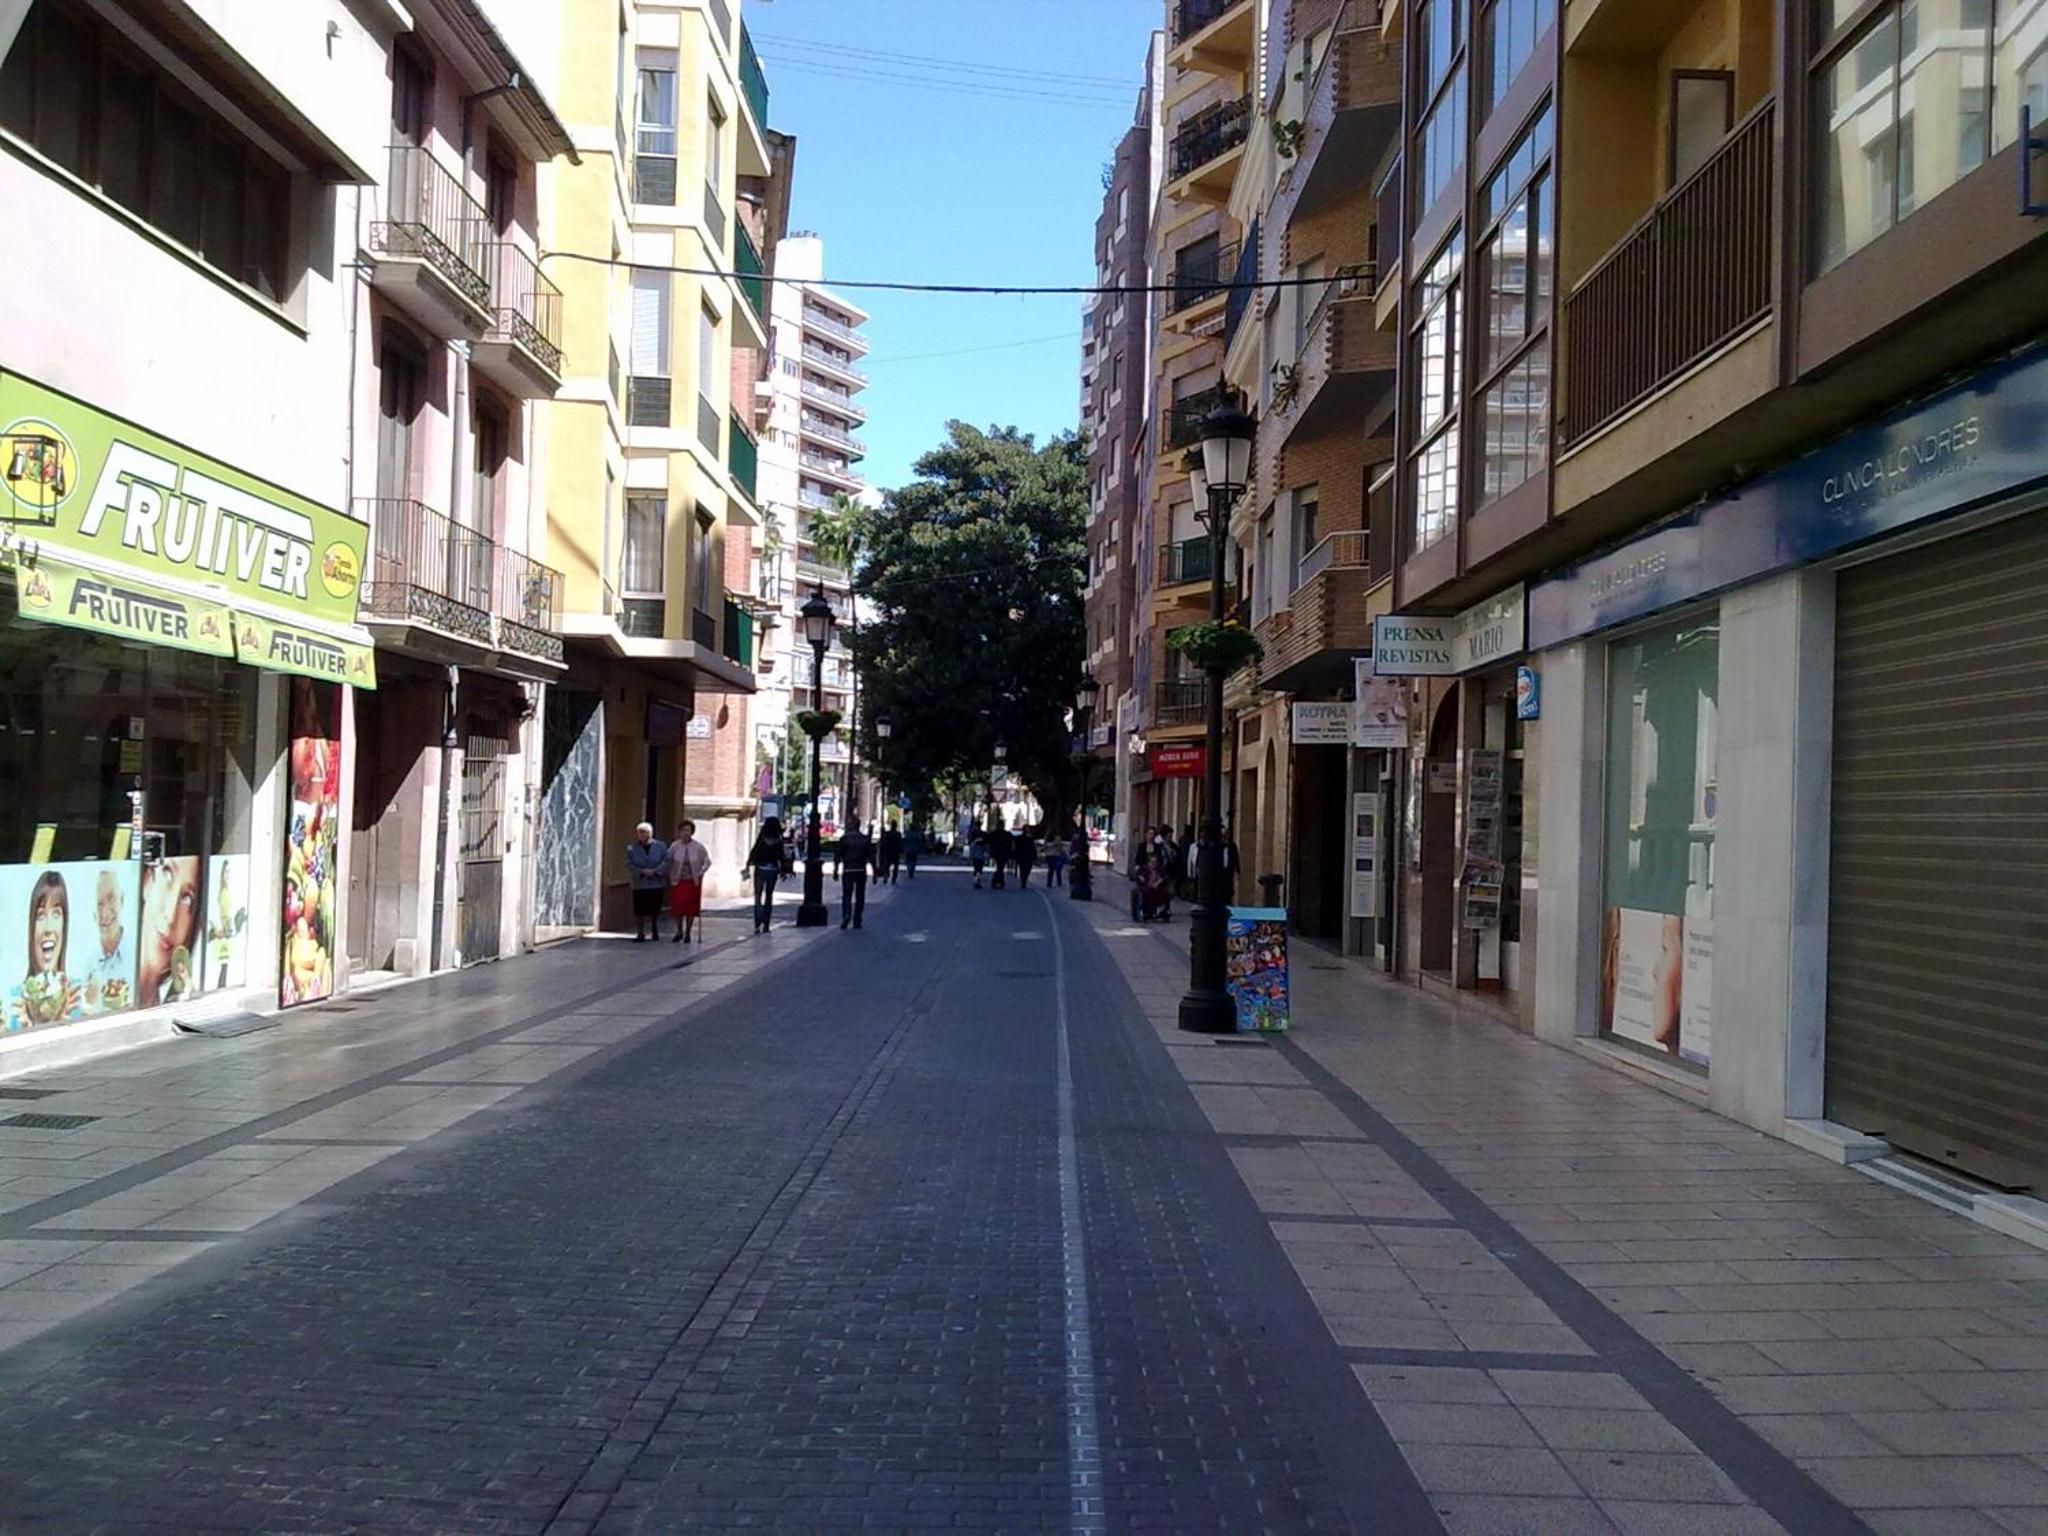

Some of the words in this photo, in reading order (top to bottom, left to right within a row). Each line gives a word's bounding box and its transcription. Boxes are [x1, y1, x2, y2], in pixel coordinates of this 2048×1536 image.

[1887, 416, 1979, 479] LONDRES
[78, 438, 314, 600] FRUTIVER
[68, 578, 188, 639] FRUTIVER
[268, 630, 347, 676] FRUTIVER
[1378, 649, 1451, 663] REVISTAS
[1384, 627, 1444, 641] PRENSA
[1469, 625, 1504, 660] MARIO
